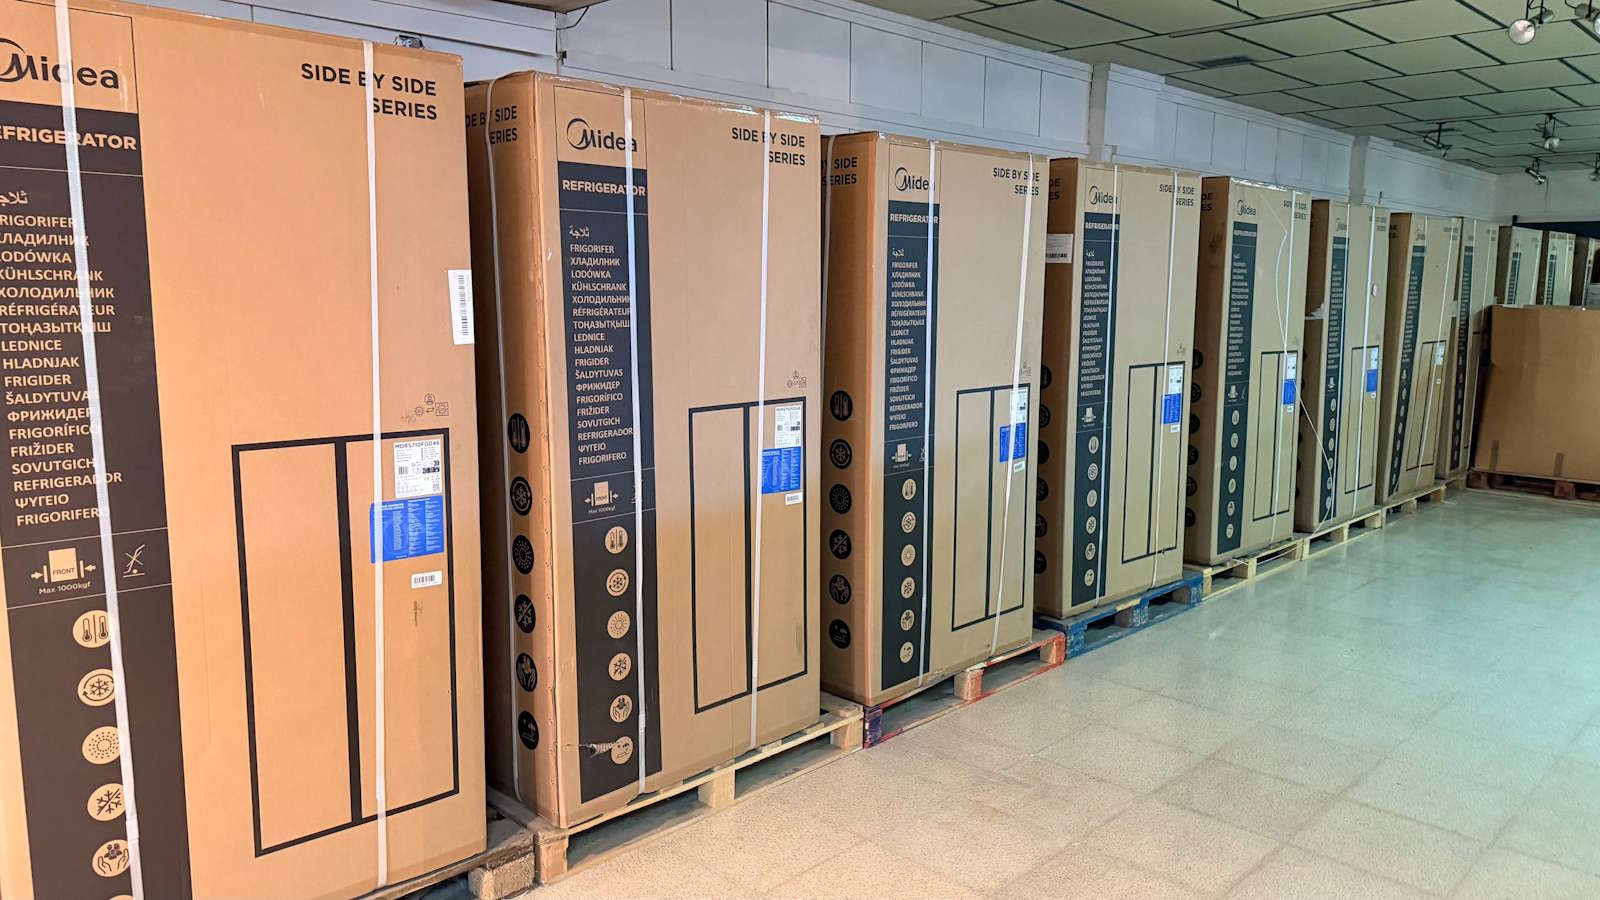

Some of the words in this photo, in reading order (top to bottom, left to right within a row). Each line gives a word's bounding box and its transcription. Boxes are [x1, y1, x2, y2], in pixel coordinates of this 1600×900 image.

[301, 63, 351, 85] SIDE
[392, 76, 437, 96] SIDE
[496, 105, 517, 122] SIDE
[0, 125, 136, 150] FRIGEATOR
[484, 127, 517, 145] ERIES
[732, 127, 758, 142] SIDE
[762, 131, 777, 144] Y
[780, 133, 805, 148] SIDE
[834, 156, 858, 169] SIDE
[895, 167, 935, 191] Mide
[993, 167, 1010, 179] SIDE
[1012, 169, 1022, 180] BY
[1024, 170, 1040, 182] SE
[562, 179, 646, 197] REFRIGERAOR
[1014, 184, 1039, 196] SERES
[1089, 185, 1117, 205] Mide
[1159, 183, 1172, 193] SIDE
[1183, 186, 1195, 195] SIDE
[889, 212, 939, 225] REFRIGERATR
[570, 243, 614, 254] FRIGORIFER
[0, 249, 72, 264] ODÓWKA
[570, 256, 620, 268] ХЛАДИЛНИК
[571, 281, 627, 292] KÜHLSCHRANK
[0, 302, 115, 316] RÉFRIGÉRAUR
[574, 332, 605, 342] LEDNICE
[2, 340, 62, 352] LEDNICE
[574, 344, 614, 355] HLADNJAK
[3, 357, 80, 369] HLADNJAK
[575, 357, 609, 367] FRIGIDER
[5, 374, 71, 388] FRIGIDER
[575, 369, 623, 380] ŠALDYTUVAS
[576, 381, 620, 391] ФРИЖИДЕР
[6, 391, 93, 405] ŠALDYTUVA
[576, 392, 623, 404] FRIGORÍFICO
[577, 405, 610, 416] FRIŽIDER
[577, 417, 621, 429] SOVUTGICH
[9, 423, 94, 440] FRIGORÍFIC
[11, 442, 75, 457] FRIŽIDER
[578, 451, 627, 466] FRIGORIFERO
[12, 458, 96, 475] SOVUTGICH
[17, 507, 100, 526] FRIGORIFER
[52, 566, 75, 576] FRONT
[39, 586, 56, 596] Max
[58, 581, 92, 592] 1000kgf
